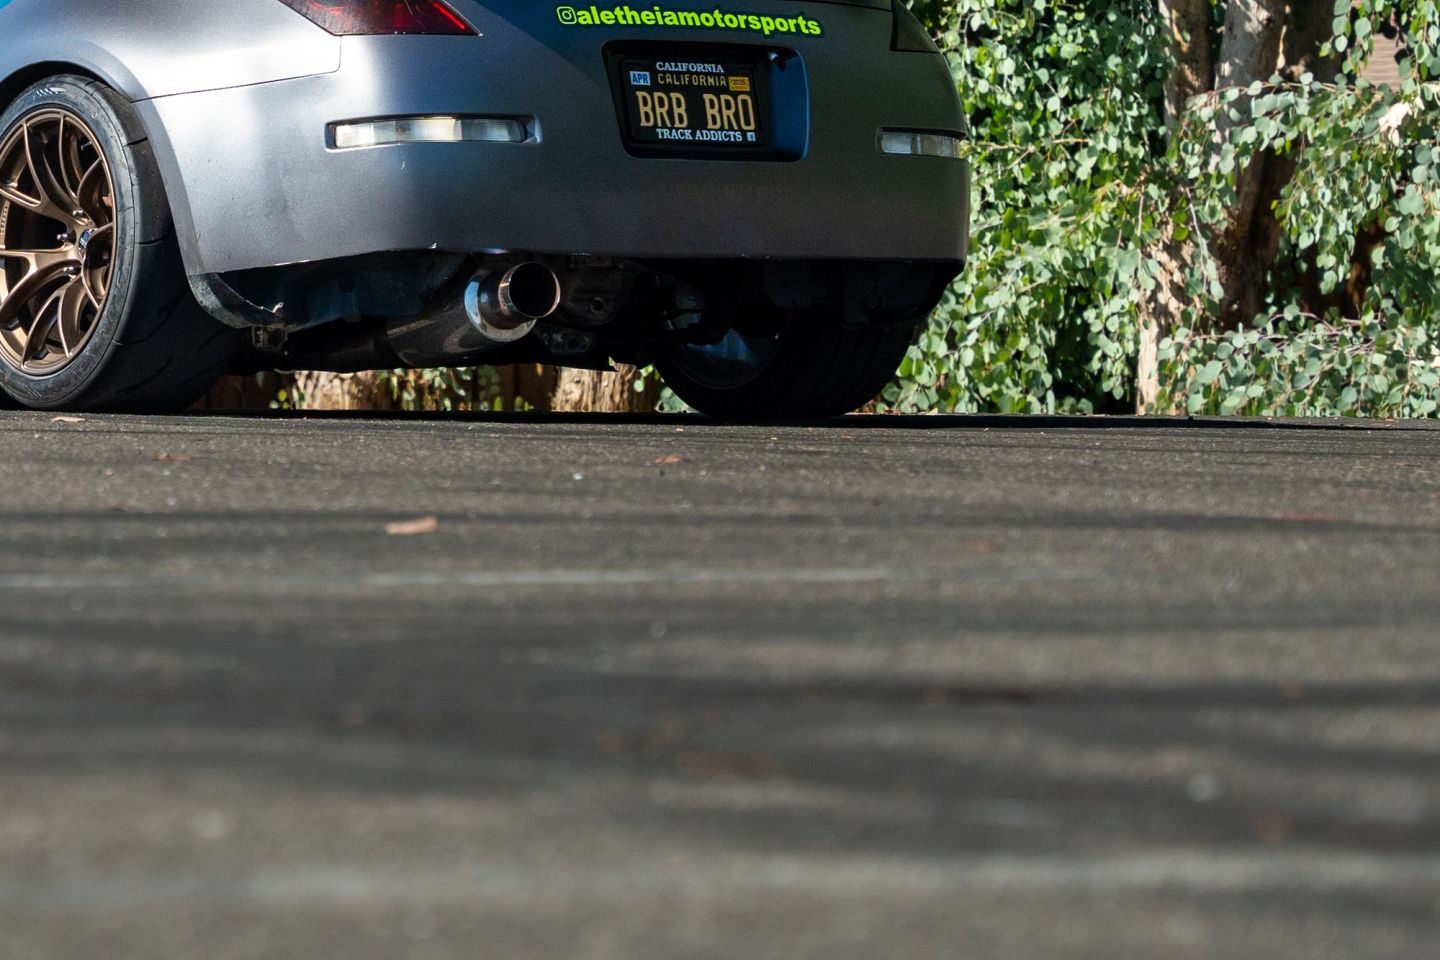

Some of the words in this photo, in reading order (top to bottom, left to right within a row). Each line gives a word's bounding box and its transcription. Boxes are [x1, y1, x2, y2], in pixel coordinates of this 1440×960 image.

[655, 61, 725, 74] CALIFORNIA
[632, 72, 649, 84] APR
[657, 73, 727, 87] CALIFORNIA
[636, 91, 688, 128] BRB
[702, 93, 756, 131] BRO
[655, 128, 693, 140] TRACK
[695, 130, 743, 142] ADDICTS
